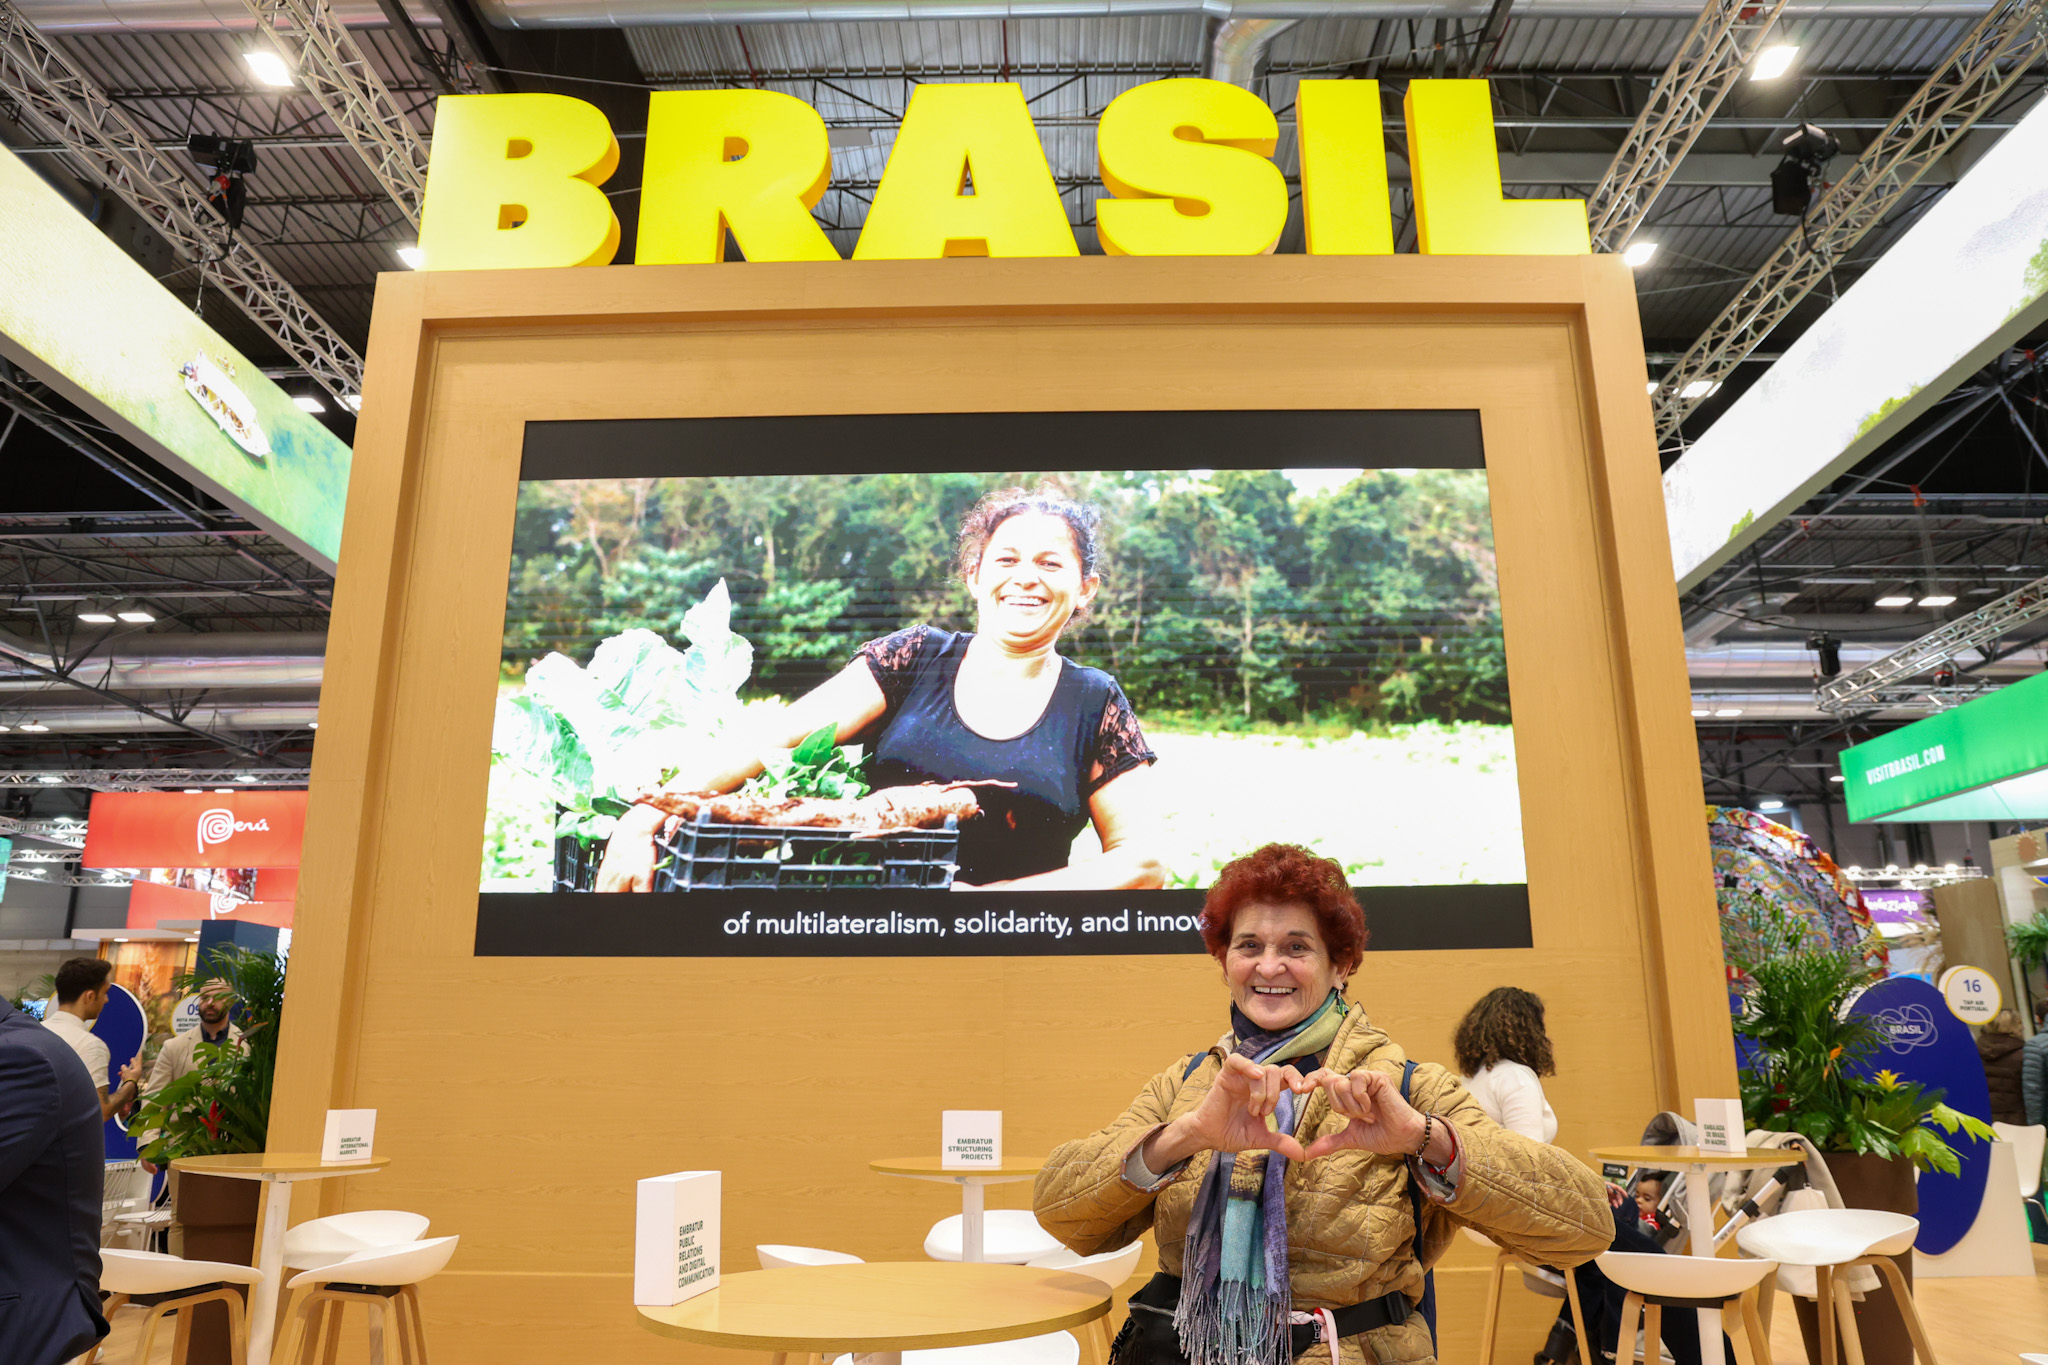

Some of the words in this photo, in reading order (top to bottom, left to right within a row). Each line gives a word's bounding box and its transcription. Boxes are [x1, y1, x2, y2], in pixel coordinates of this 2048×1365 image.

[419, 77, 1593, 270] BRASIL
[1865, 744, 1946, 785] VISITBRASIL.COM
[197, 808, 270, 853] Perú
[723, 910, 751, 935] of
[756, 910, 947, 938] multilateralism,
[954, 909, 1073, 939] solidarity,
[1081, 910, 1129, 933] and
[1137, 910, 1202, 932] innov
[1963, 979, 1982, 993] 16
[1888, 1024, 1925, 1035] BRASIL
[679, 1220, 704, 1236] EMBRATUR
[679, 1235, 695, 1249] PUBLIC
[679, 1245, 703, 1262] RELATIONS
[678, 1262, 689, 1275] AND
[689, 1257, 706, 1272] DIGITAL
[678, 1265, 715, 1289] COMMUNICATION
